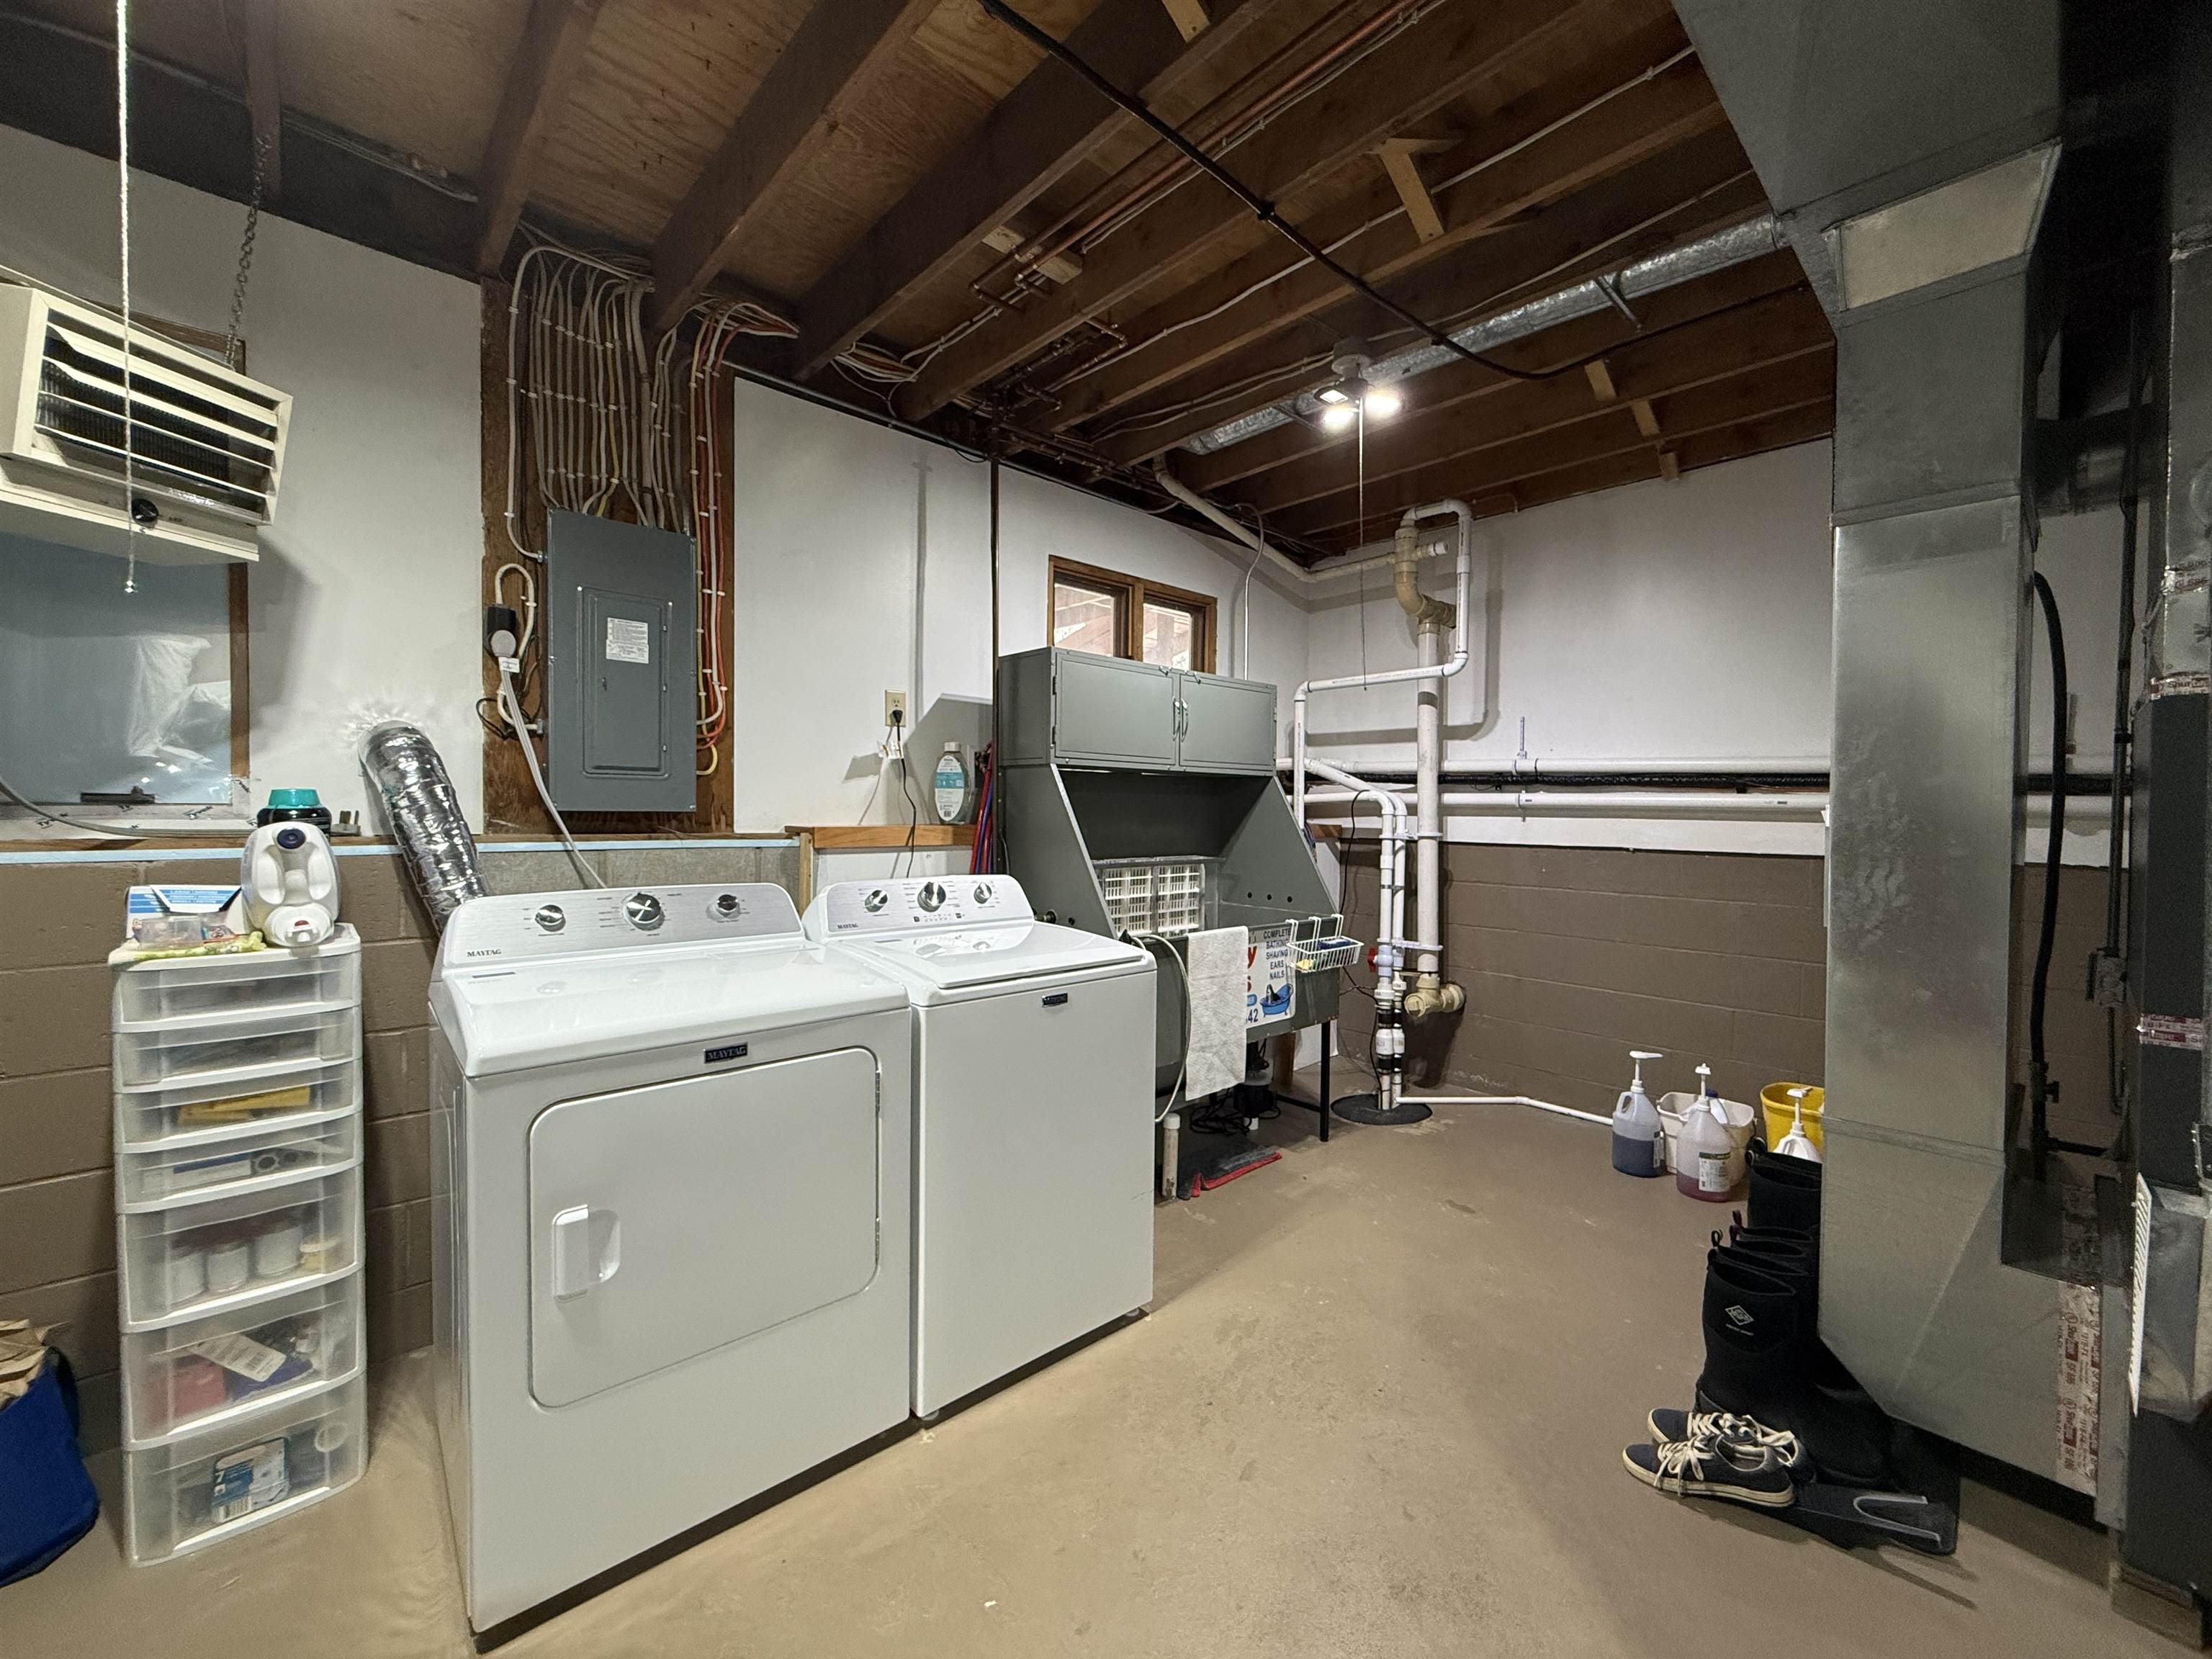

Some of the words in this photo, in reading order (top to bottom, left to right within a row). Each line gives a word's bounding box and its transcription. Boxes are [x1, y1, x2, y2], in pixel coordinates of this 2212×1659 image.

[1264, 928, 1290, 939] COMPLETE
[1266, 949, 1287, 960] SHAVING
[1270, 960, 1284, 969] EARS
[1269, 970, 1285, 980] NAILS
[1246, 1008, 1259, 1023] 42
[707, 1046, 746, 1060] MAYTAG
